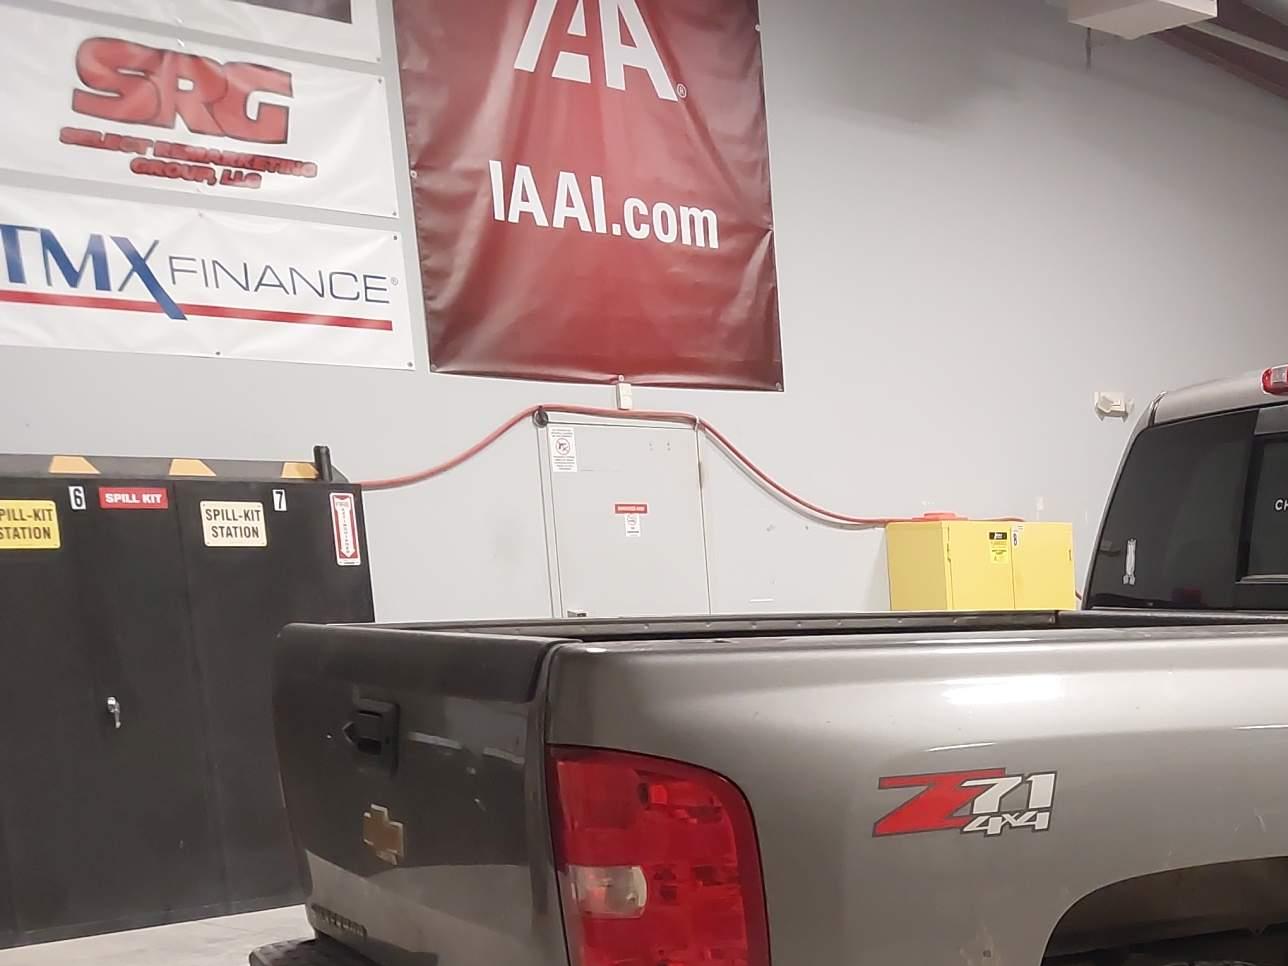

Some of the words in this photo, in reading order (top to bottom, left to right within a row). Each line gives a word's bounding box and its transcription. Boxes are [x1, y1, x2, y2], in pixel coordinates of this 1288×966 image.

[72, 37, 292, 144] SRG
[489, 160, 719, 248] IAAI.com
[0, 224, 188, 321] TMX
[169, 255, 391, 304] FINANCE
[73, 488, 84, 508] 6
[105, 493, 140, 504] SPILL
[142, 494, 162, 504] KIT
[275, 491, 284, 509] 7
[0, 508, 53, 522] PILL-KIT
[205, 508, 260, 522] SPILL-KIT
[211, 526, 260, 539] STATION
[872, 767, 1057, 837] Z71
